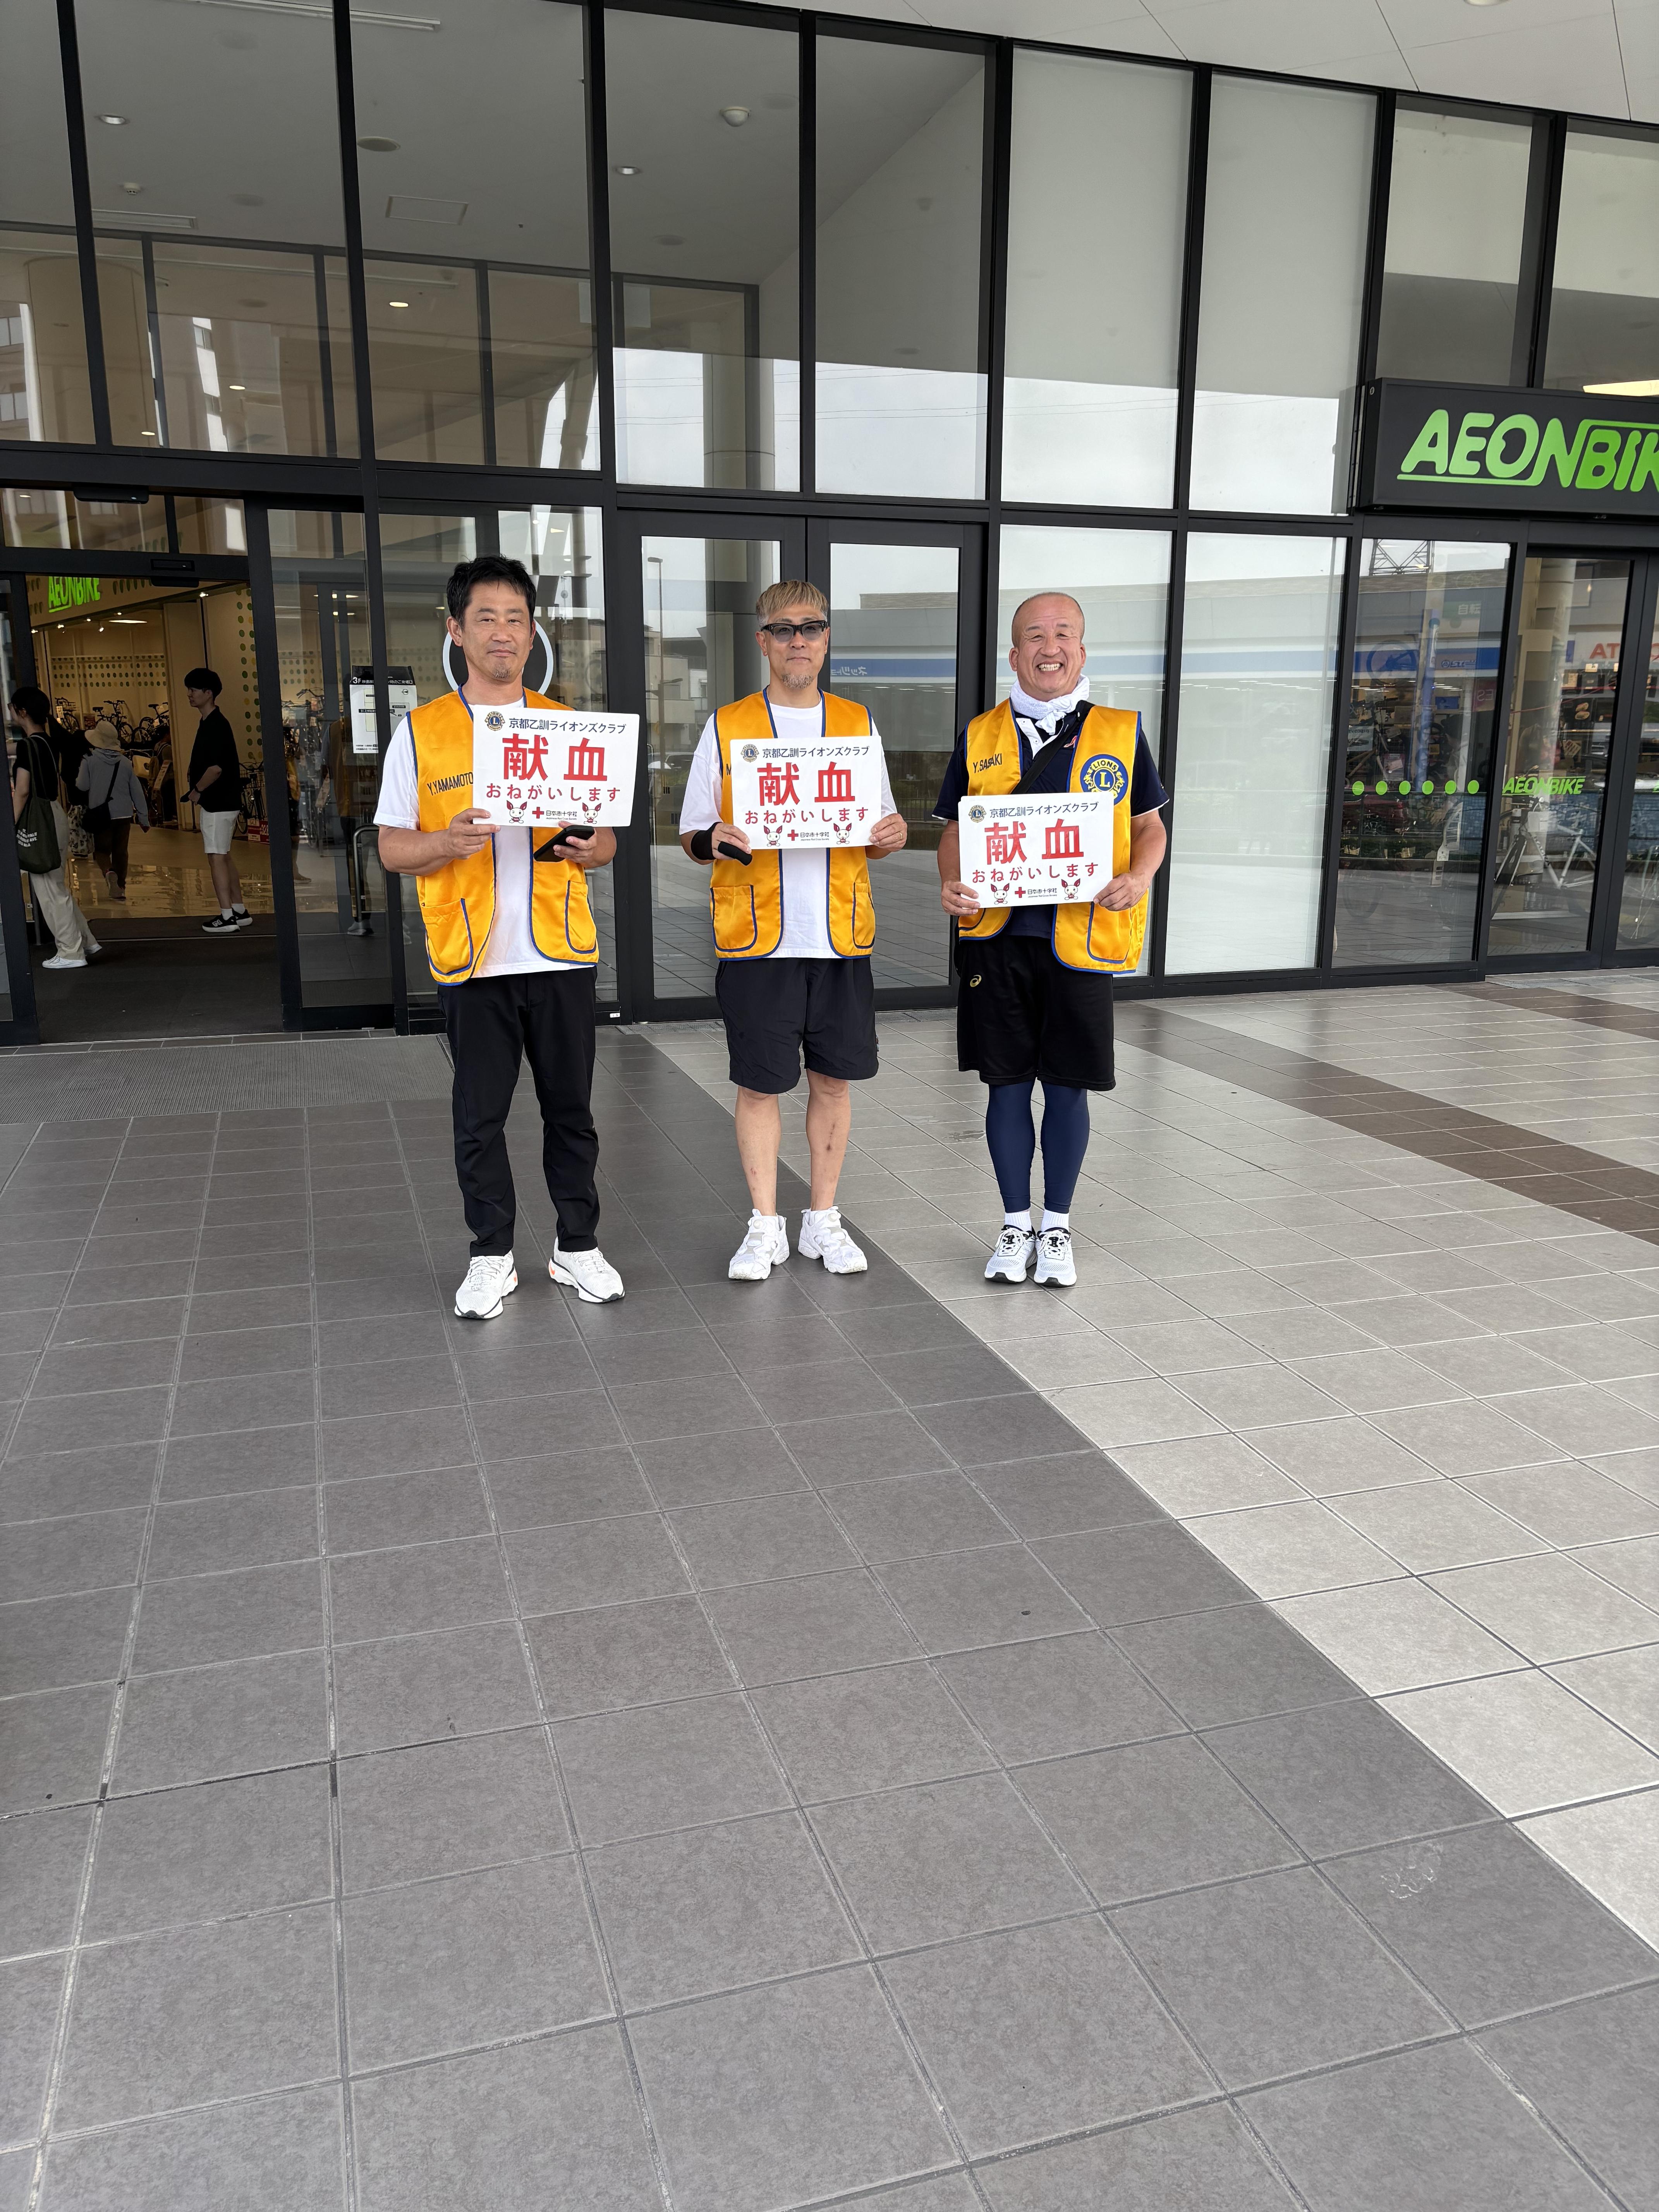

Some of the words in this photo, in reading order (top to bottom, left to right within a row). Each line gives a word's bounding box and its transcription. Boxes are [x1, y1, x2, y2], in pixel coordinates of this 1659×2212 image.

[508, 718, 627, 734] 京都乙訓ライオンズクラブ
[762, 745, 870, 758] 京都乙訓ライオンズクラブ
[973, 753, 1002, 774] Y.SASAKI
[1093, 760, 1117, 770] LIONS
[427, 771, 473, 796] Y.YAMAMOTO
[486, 783, 620, 802] おねがいします
[1502, 776, 1586, 795] AEONBIKE
[745, 807, 869, 824] おねがいします
[989, 801, 1099, 818] 京都乙訓ライオンズクラブ
[972, 862, 1098, 883] おねがいします
